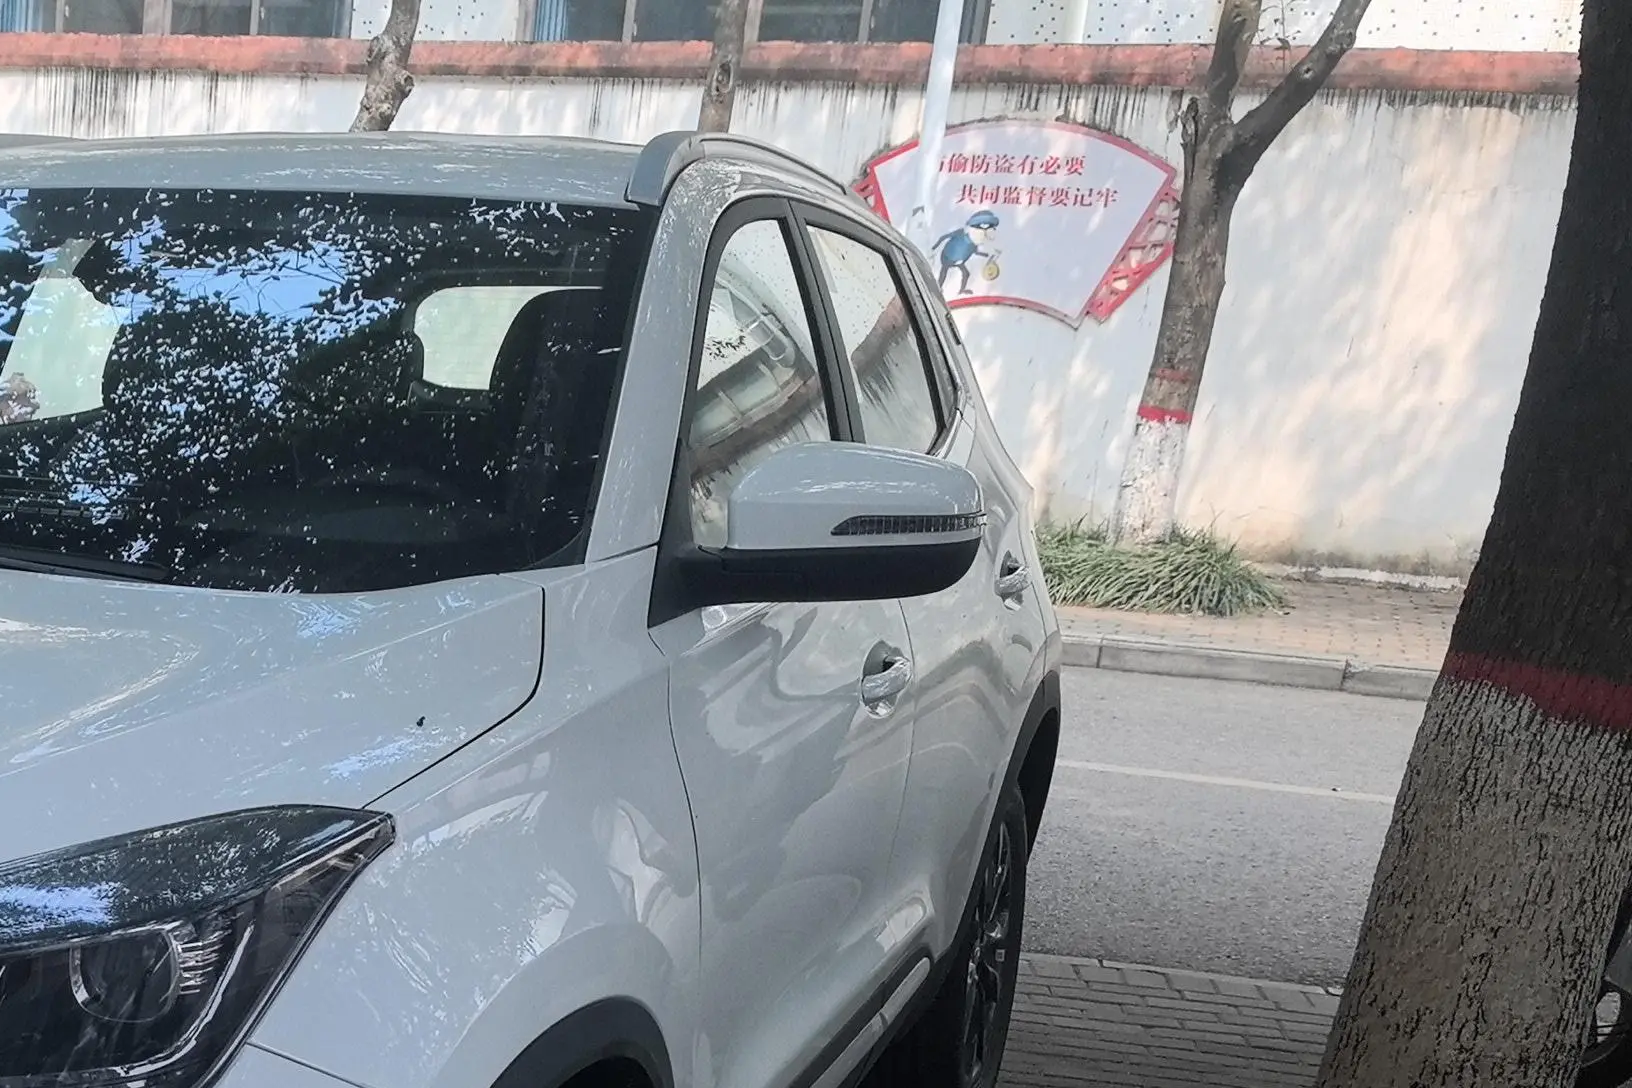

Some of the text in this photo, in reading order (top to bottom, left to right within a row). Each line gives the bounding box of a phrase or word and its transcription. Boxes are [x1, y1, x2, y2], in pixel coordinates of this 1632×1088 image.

[939, 153, 1087, 176] 偷防盗有必要
[956, 184, 1118, 209] 共同监督要记牢
